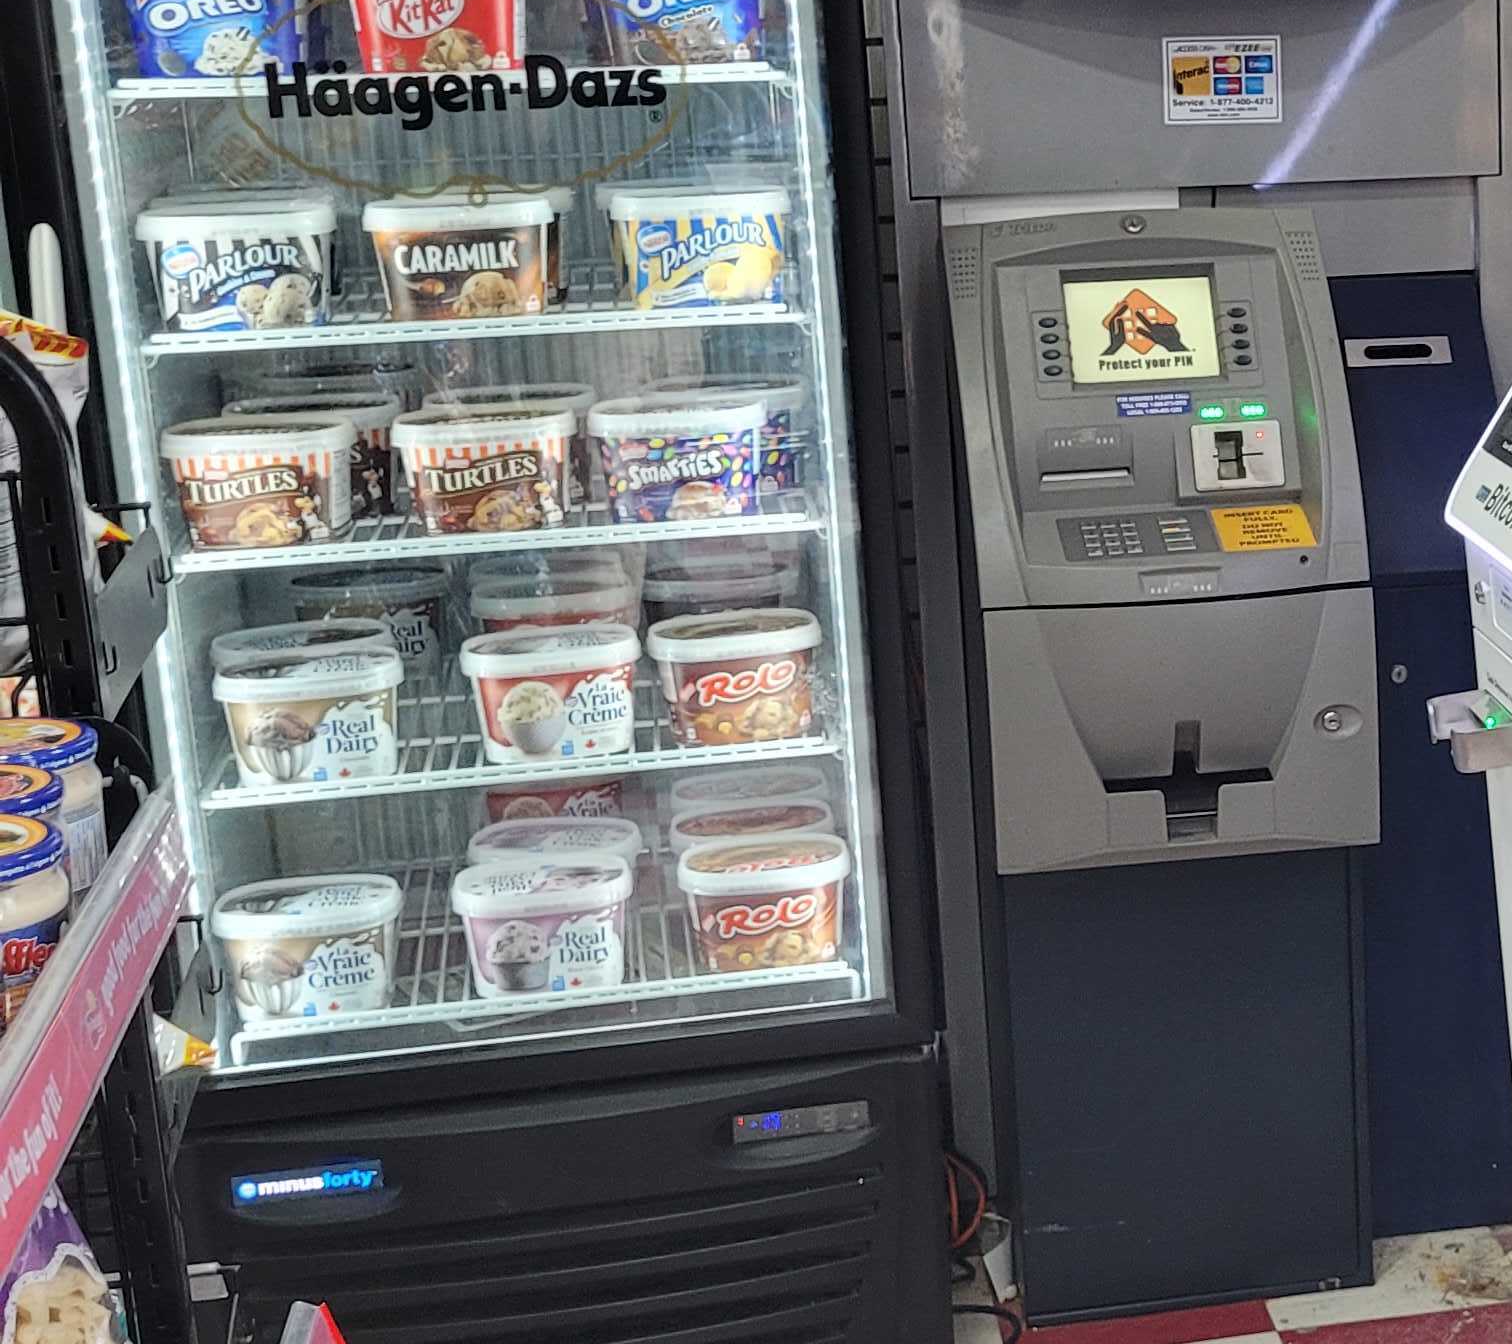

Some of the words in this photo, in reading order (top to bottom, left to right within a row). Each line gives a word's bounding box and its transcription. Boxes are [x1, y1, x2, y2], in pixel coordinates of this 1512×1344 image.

[660, 5, 713, 28] Chocolate
[266, 54, 667, 130] Häagen-Dazs
[396, 240, 518, 274] CARAMILK
[662, 222, 765, 281] PARLOUR
[189, 244, 302, 304] PARLOUR
[1098, 359, 1142, 370] Protect
[1145, 358, 1172, 370] your
[426, 454, 538, 494] TURTLES
[186, 470, 299, 504] TURTLES
[699, 662, 796, 704] Rolo
[576, 685, 625, 710] Vraie
[332, 715, 375, 737] Real
[568, 704, 628, 726] Crème
[326, 735, 379, 754] Dairy
[717, 895, 816, 937] Rolo
[563, 927, 606, 947] Real
[317, 950, 372, 972] Vraie
[559, 944, 609, 964] Dairy
[308, 967, 376, 989] Crème
[25, 1124, 48, 1175] fun
[257, 1170, 375, 1196] minusforty
